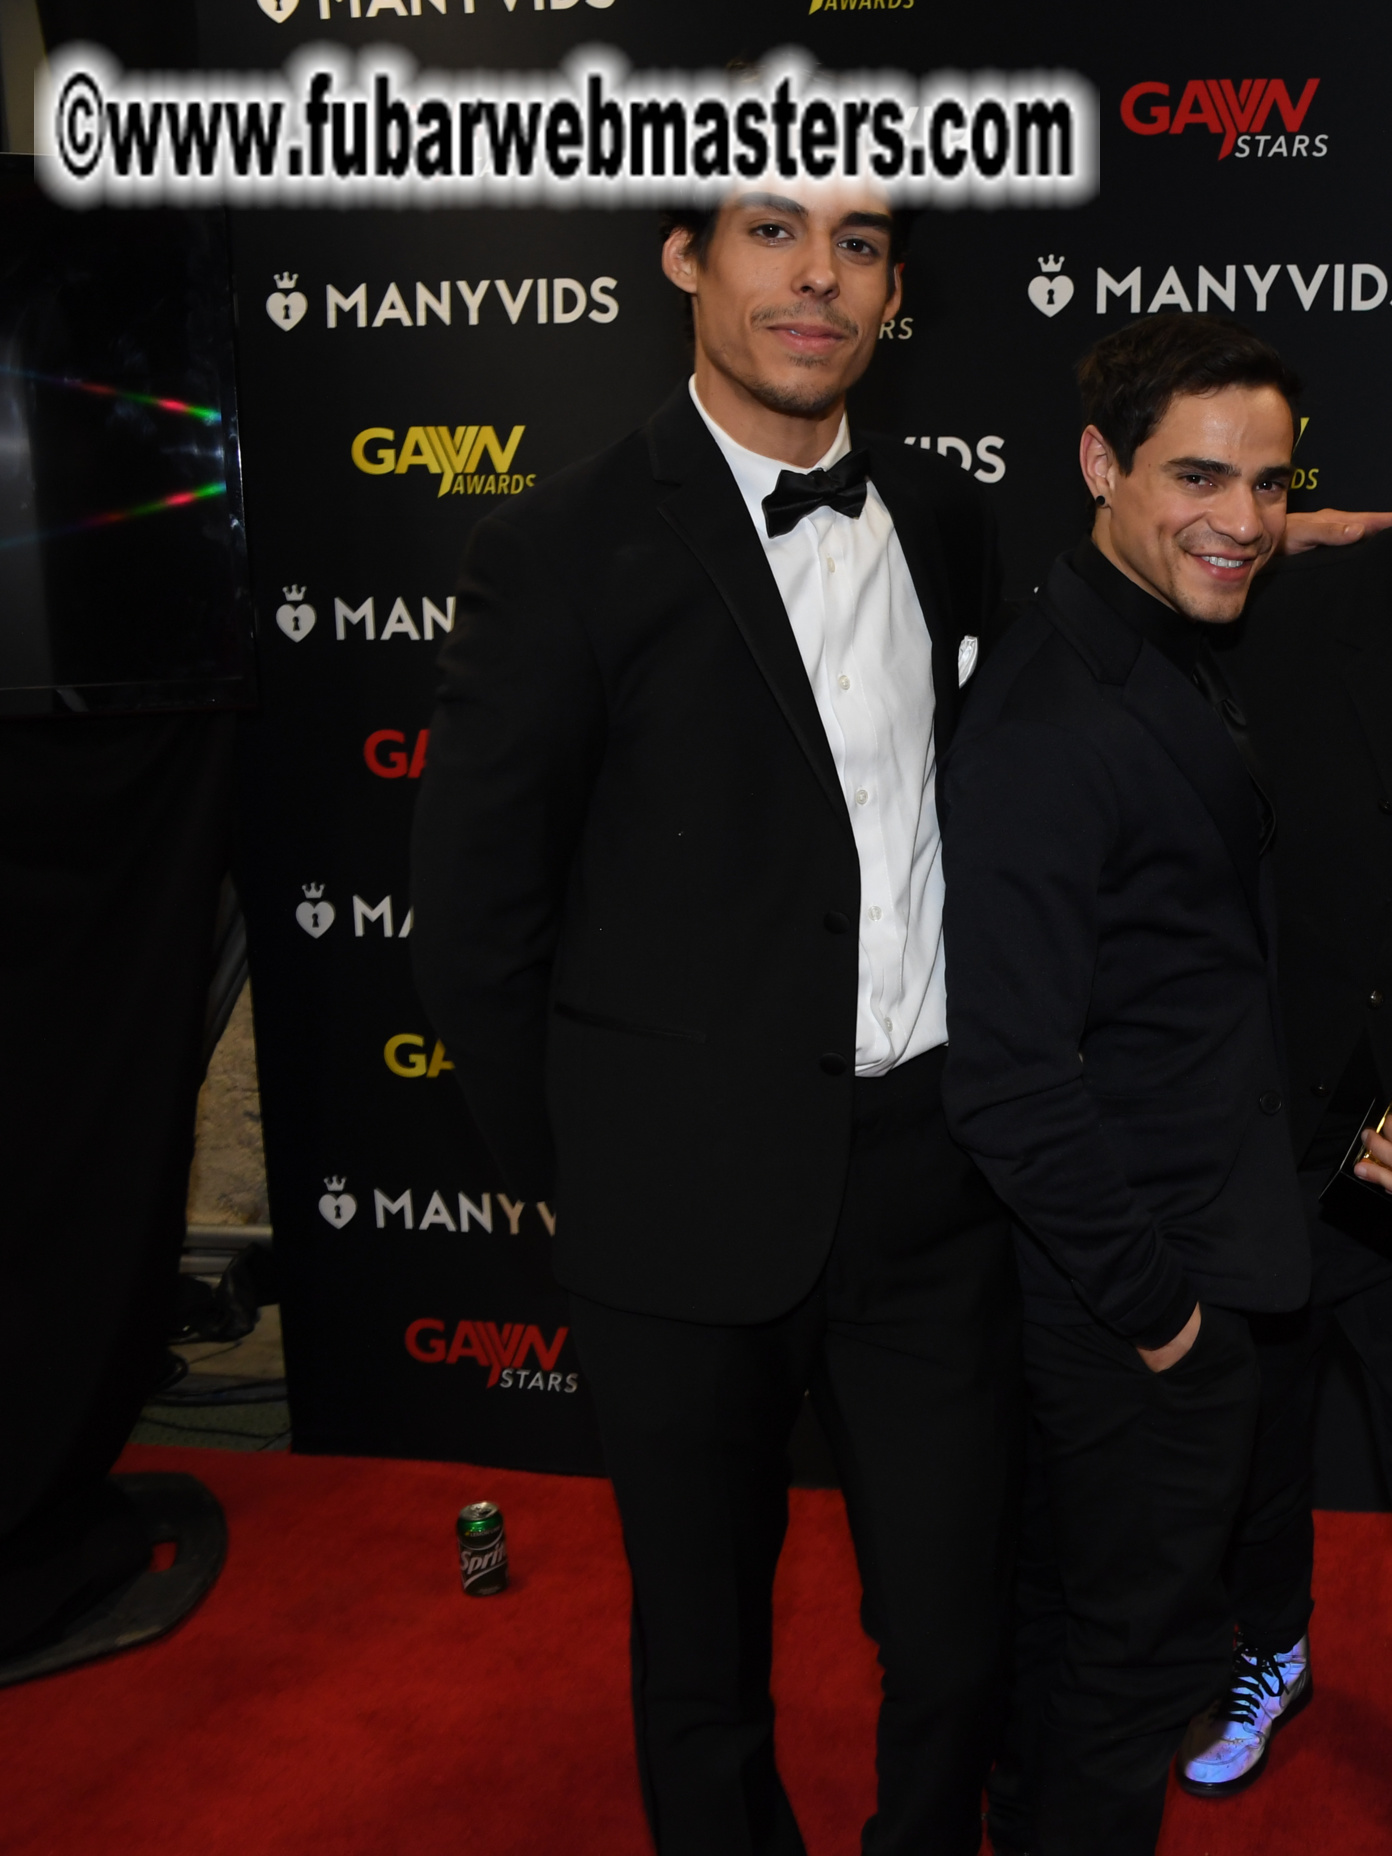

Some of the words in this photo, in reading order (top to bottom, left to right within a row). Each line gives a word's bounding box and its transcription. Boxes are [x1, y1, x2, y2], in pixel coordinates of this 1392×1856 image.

[1234, 134, 1329, 158] STARS
[326, 276, 619, 328] MANYVIDS
[500, 1368, 578, 1394] STARS
